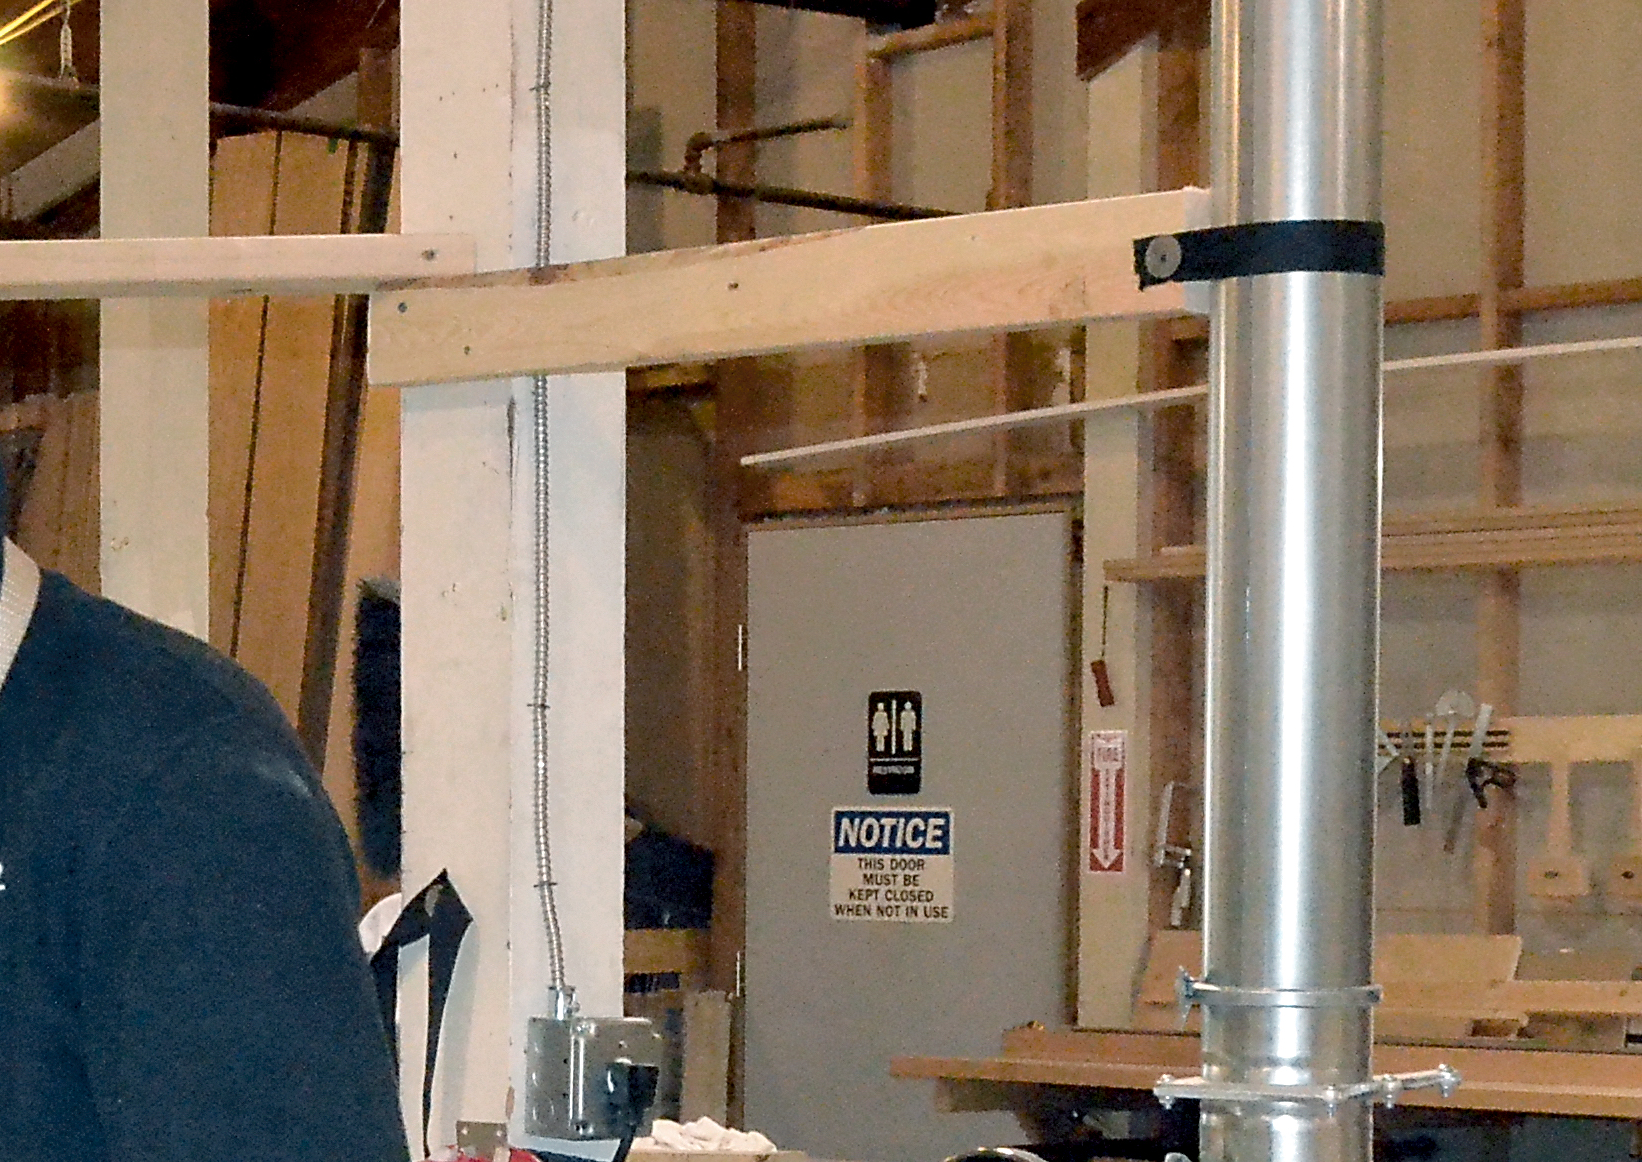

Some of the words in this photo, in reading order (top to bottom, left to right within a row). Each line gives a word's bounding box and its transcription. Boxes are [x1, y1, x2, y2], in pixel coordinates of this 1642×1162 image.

[838, 817, 946, 848] NOTICE
[858, 858, 885, 870] THIS
[890, 858, 925, 871] DOOR
[863, 873, 898, 886] MUST
[903, 874, 920, 887] BE
[849, 888, 879, 900] KEPT
[885, 889, 934, 902] CLOSED
[834, 904, 871, 916] WHEN
[877, 905, 900, 917] NOT
[906, 905, 917, 917] IN
[924, 906, 948, 918] USE
